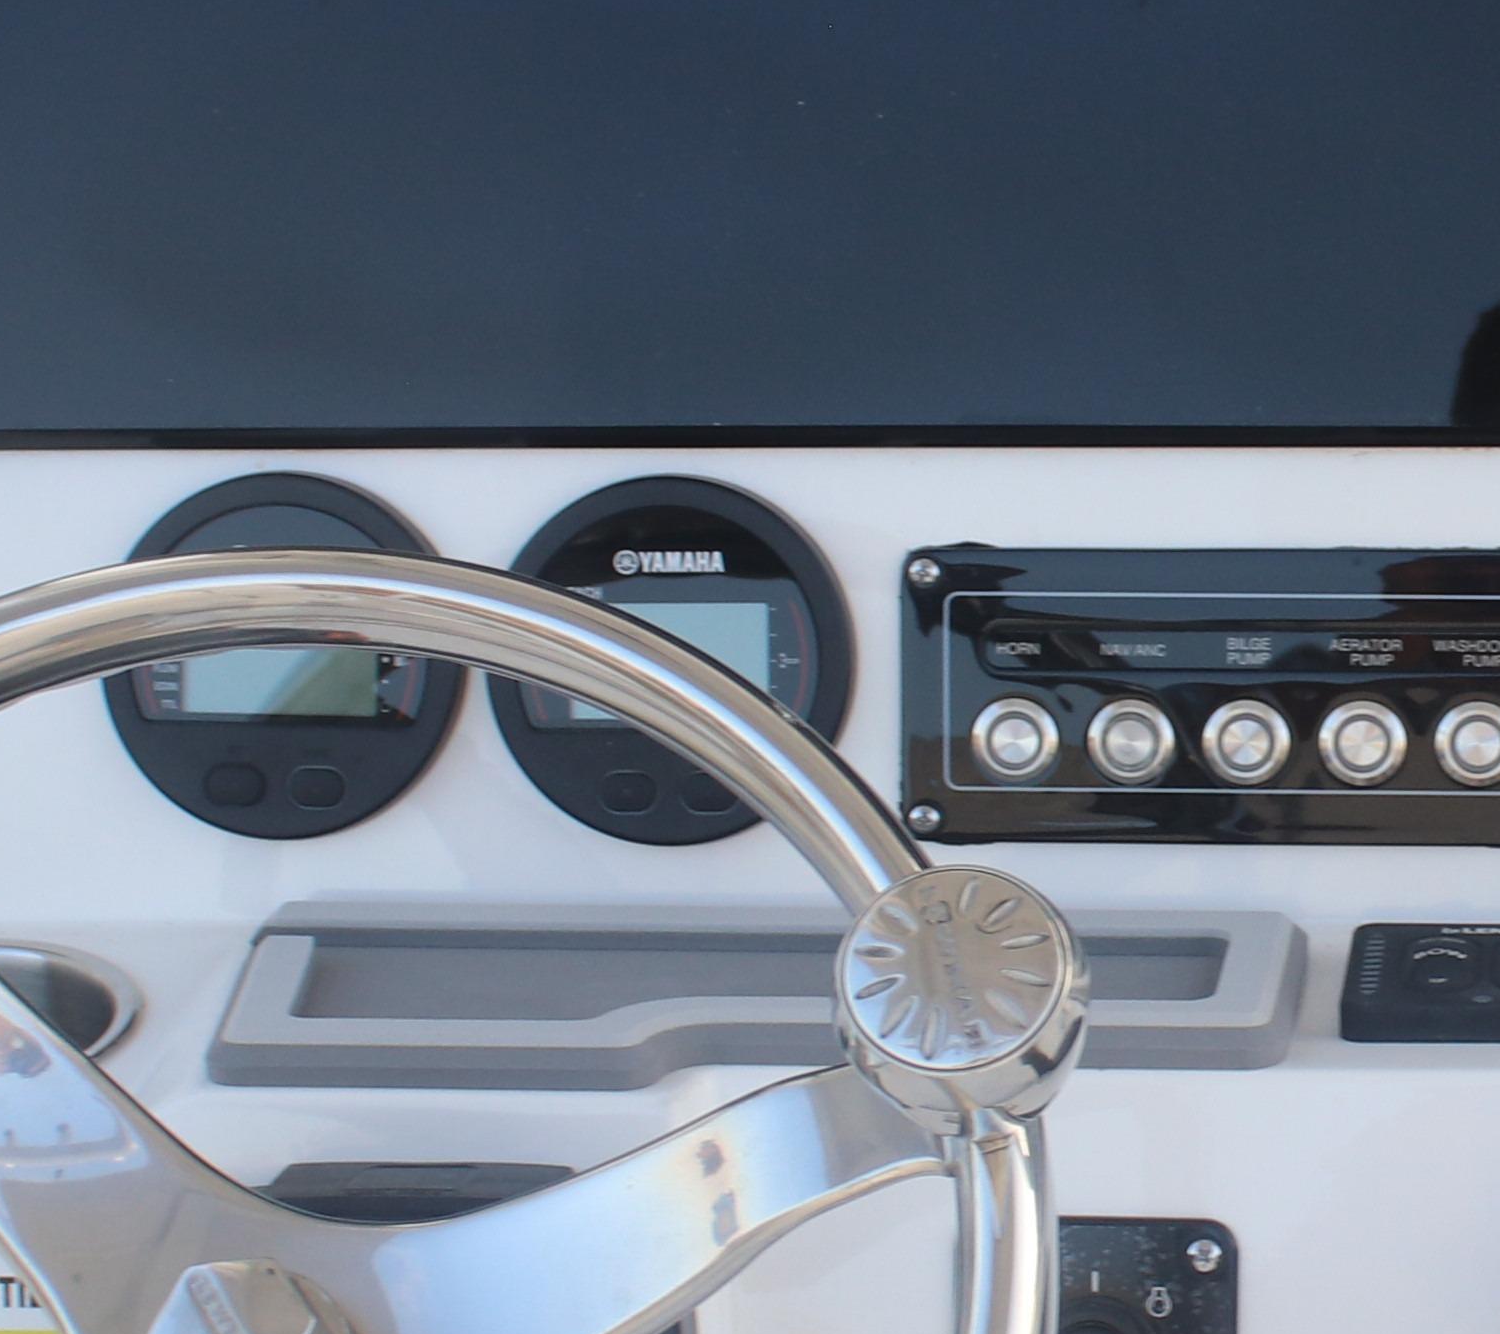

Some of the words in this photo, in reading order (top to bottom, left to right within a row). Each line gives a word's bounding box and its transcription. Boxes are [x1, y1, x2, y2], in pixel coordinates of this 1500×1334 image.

[638, 551, 726, 573] YAMAHA
[995, 642, 1041, 656] HORN
[1226, 638, 1271, 650] BILGE
[1330, 639, 1403, 652] AERATOR
[1226, 653, 1271, 665] PUMP
[1350, 654, 1395, 667] PUMP
